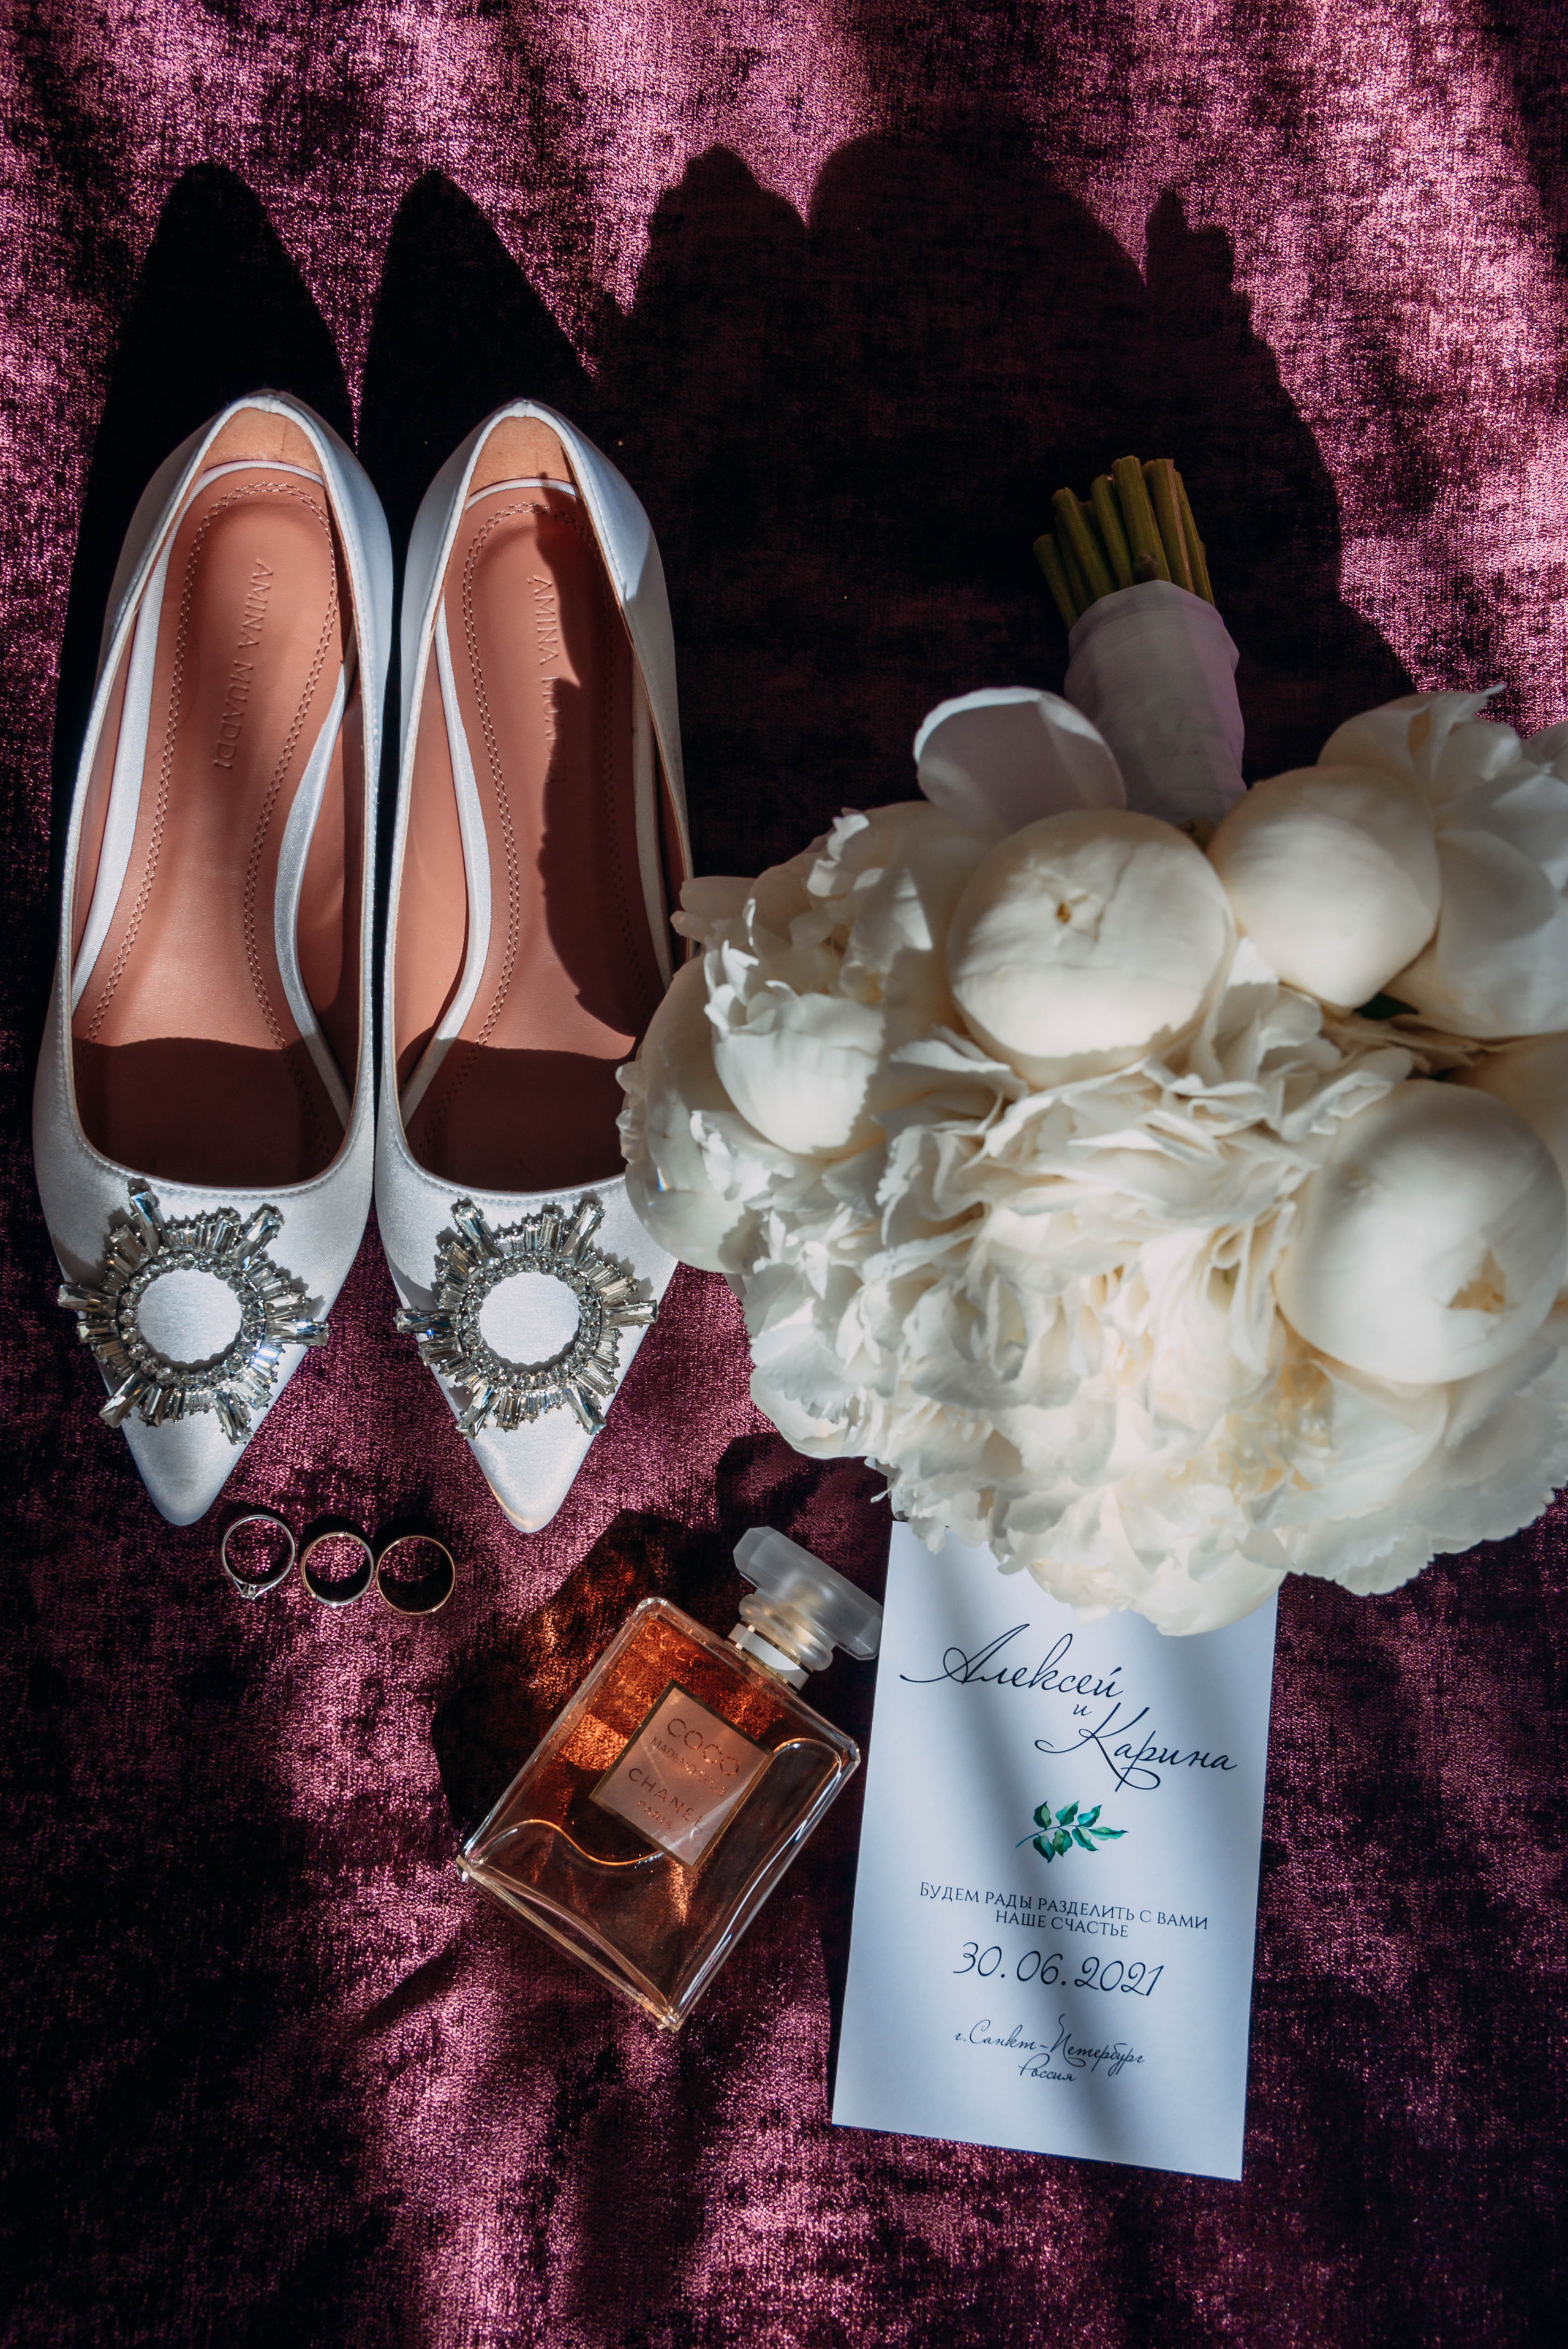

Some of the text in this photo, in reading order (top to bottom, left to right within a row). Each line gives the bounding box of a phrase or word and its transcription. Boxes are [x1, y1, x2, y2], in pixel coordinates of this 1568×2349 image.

[533, 575, 559, 665] AMINA
[213, 558, 273, 770] AMINA MUADDI
[899, 1624, 1123, 1698] Алексей
[1072, 1703, 1092, 1717] и
[667, 1718, 739, 1776] COCO
[1035, 1702, 1238, 1793] Карина
[628, 1768, 704, 1831] CHANEL
[638, 1799, 673, 1830] PARIS
[920, 1882, 1208, 1931] БУДЕМ РАДЫ РАЗДЕЛИТЬ С ВАМИ
[995, 1910, 1129, 1938] НАШЕ СЧАСТЬЕ
[1018, 2052, 1077, 2082] Россия
